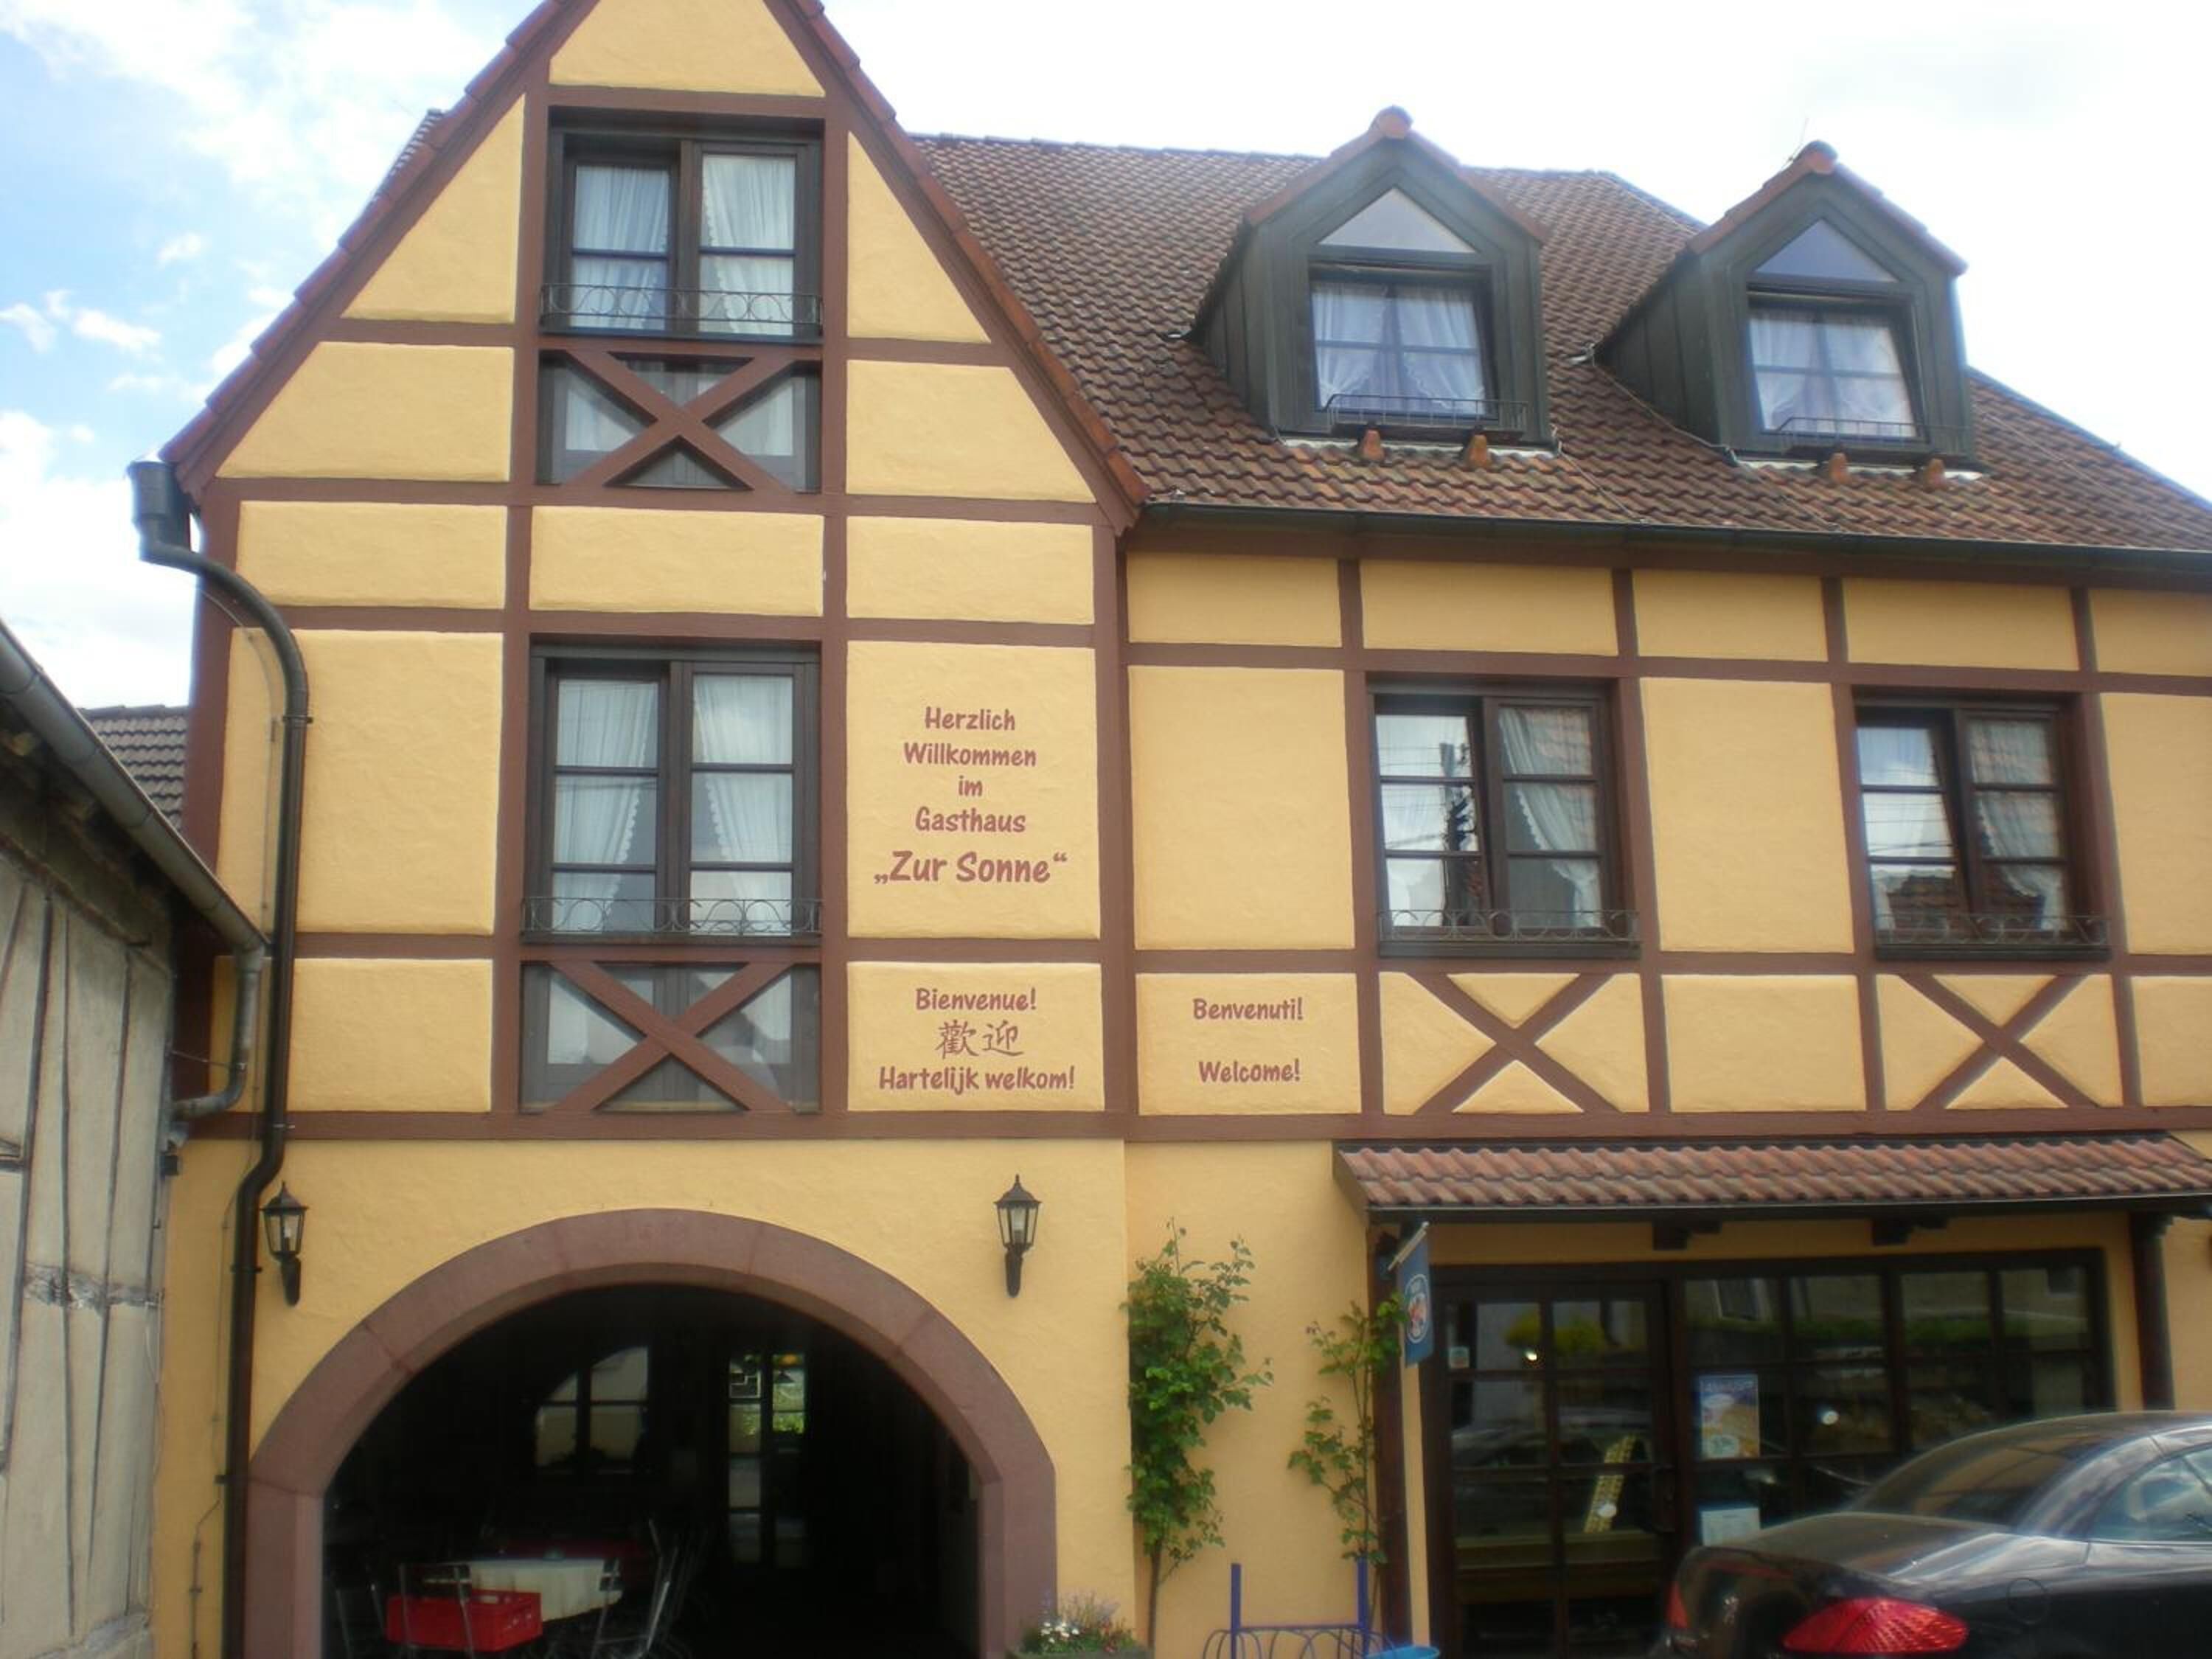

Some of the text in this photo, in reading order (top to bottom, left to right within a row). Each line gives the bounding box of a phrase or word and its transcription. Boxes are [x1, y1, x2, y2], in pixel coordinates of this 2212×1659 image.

[925, 706, 1015, 731] Herzlich
[904, 742, 1037, 768] Willkommen
[959, 775, 984, 797] im
[916, 807, 1026, 833] Gasthaus
[916, 987, 1037, 1012] Bienvenue!
[1193, 997, 1304, 1020] Benvenuti!
[936, 1019, 1024, 1060] 歡迎
[880, 1066, 1074, 1096] Hartelijk welkom!
[1199, 1059, 1301, 1083] Welcome!
